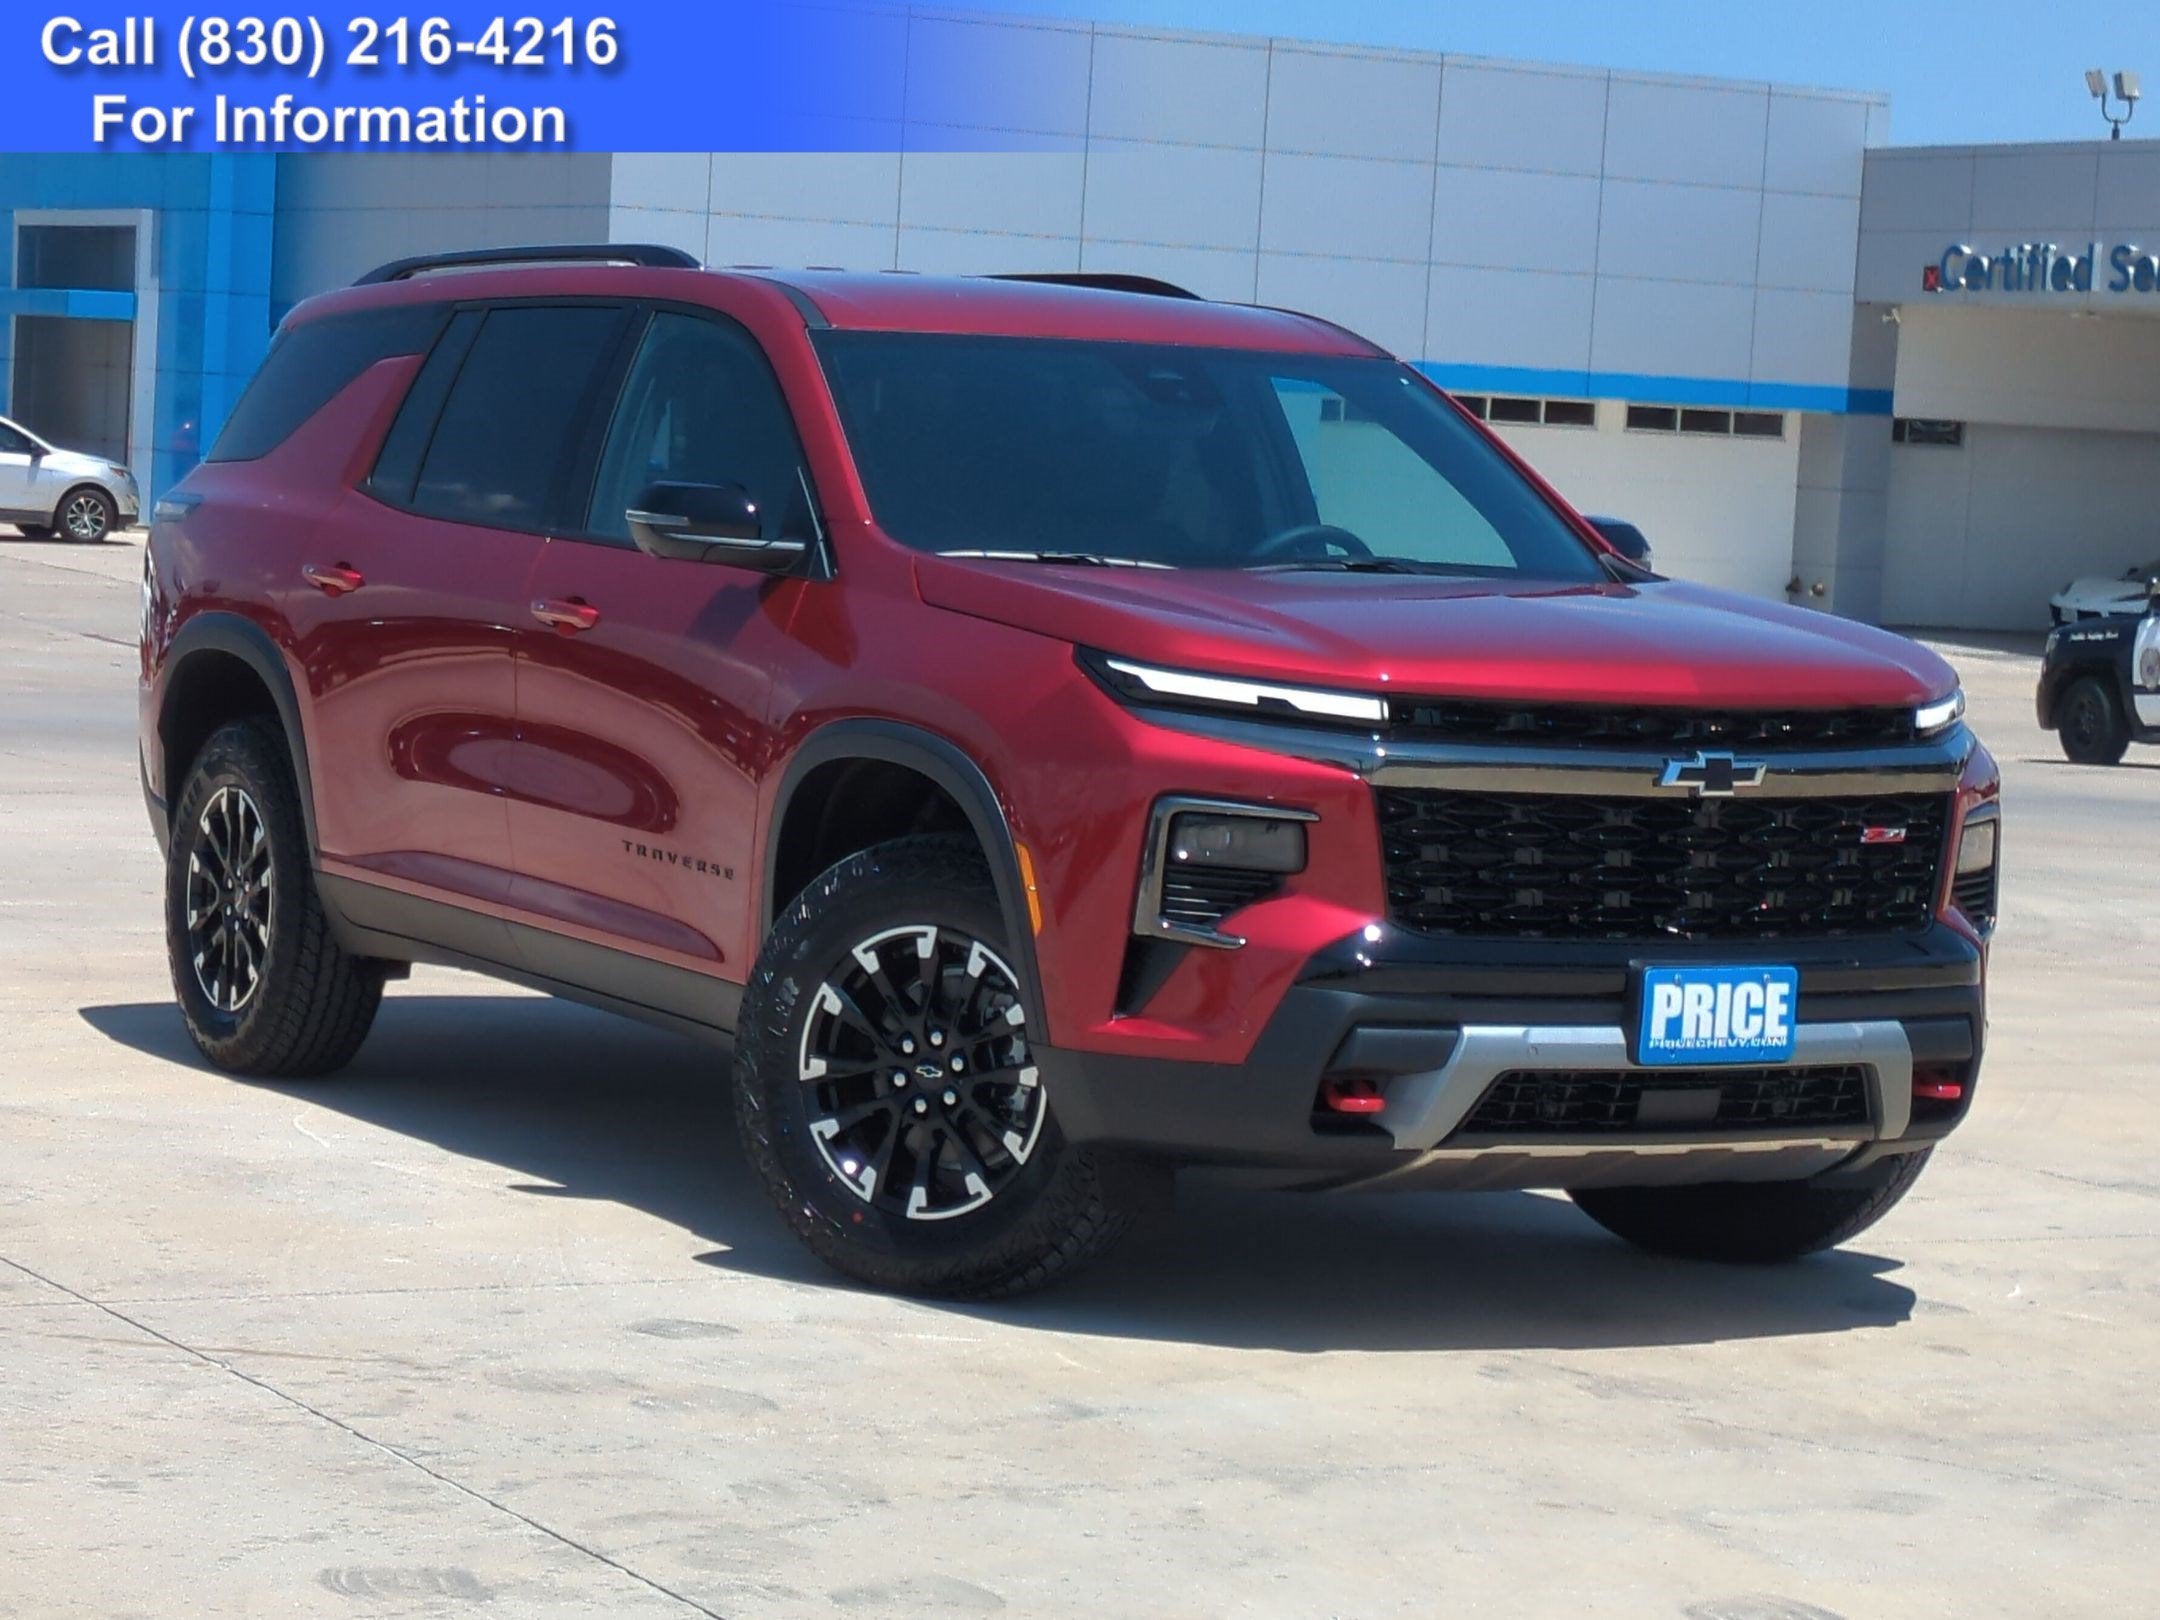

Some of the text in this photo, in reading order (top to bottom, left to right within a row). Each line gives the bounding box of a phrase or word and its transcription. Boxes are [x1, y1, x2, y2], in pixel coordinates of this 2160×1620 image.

[1940, 242, 2102, 292] Certified
[622, 839, 734, 880] TRAVERSE
[1650, 981, 1789, 1041] PRICE
